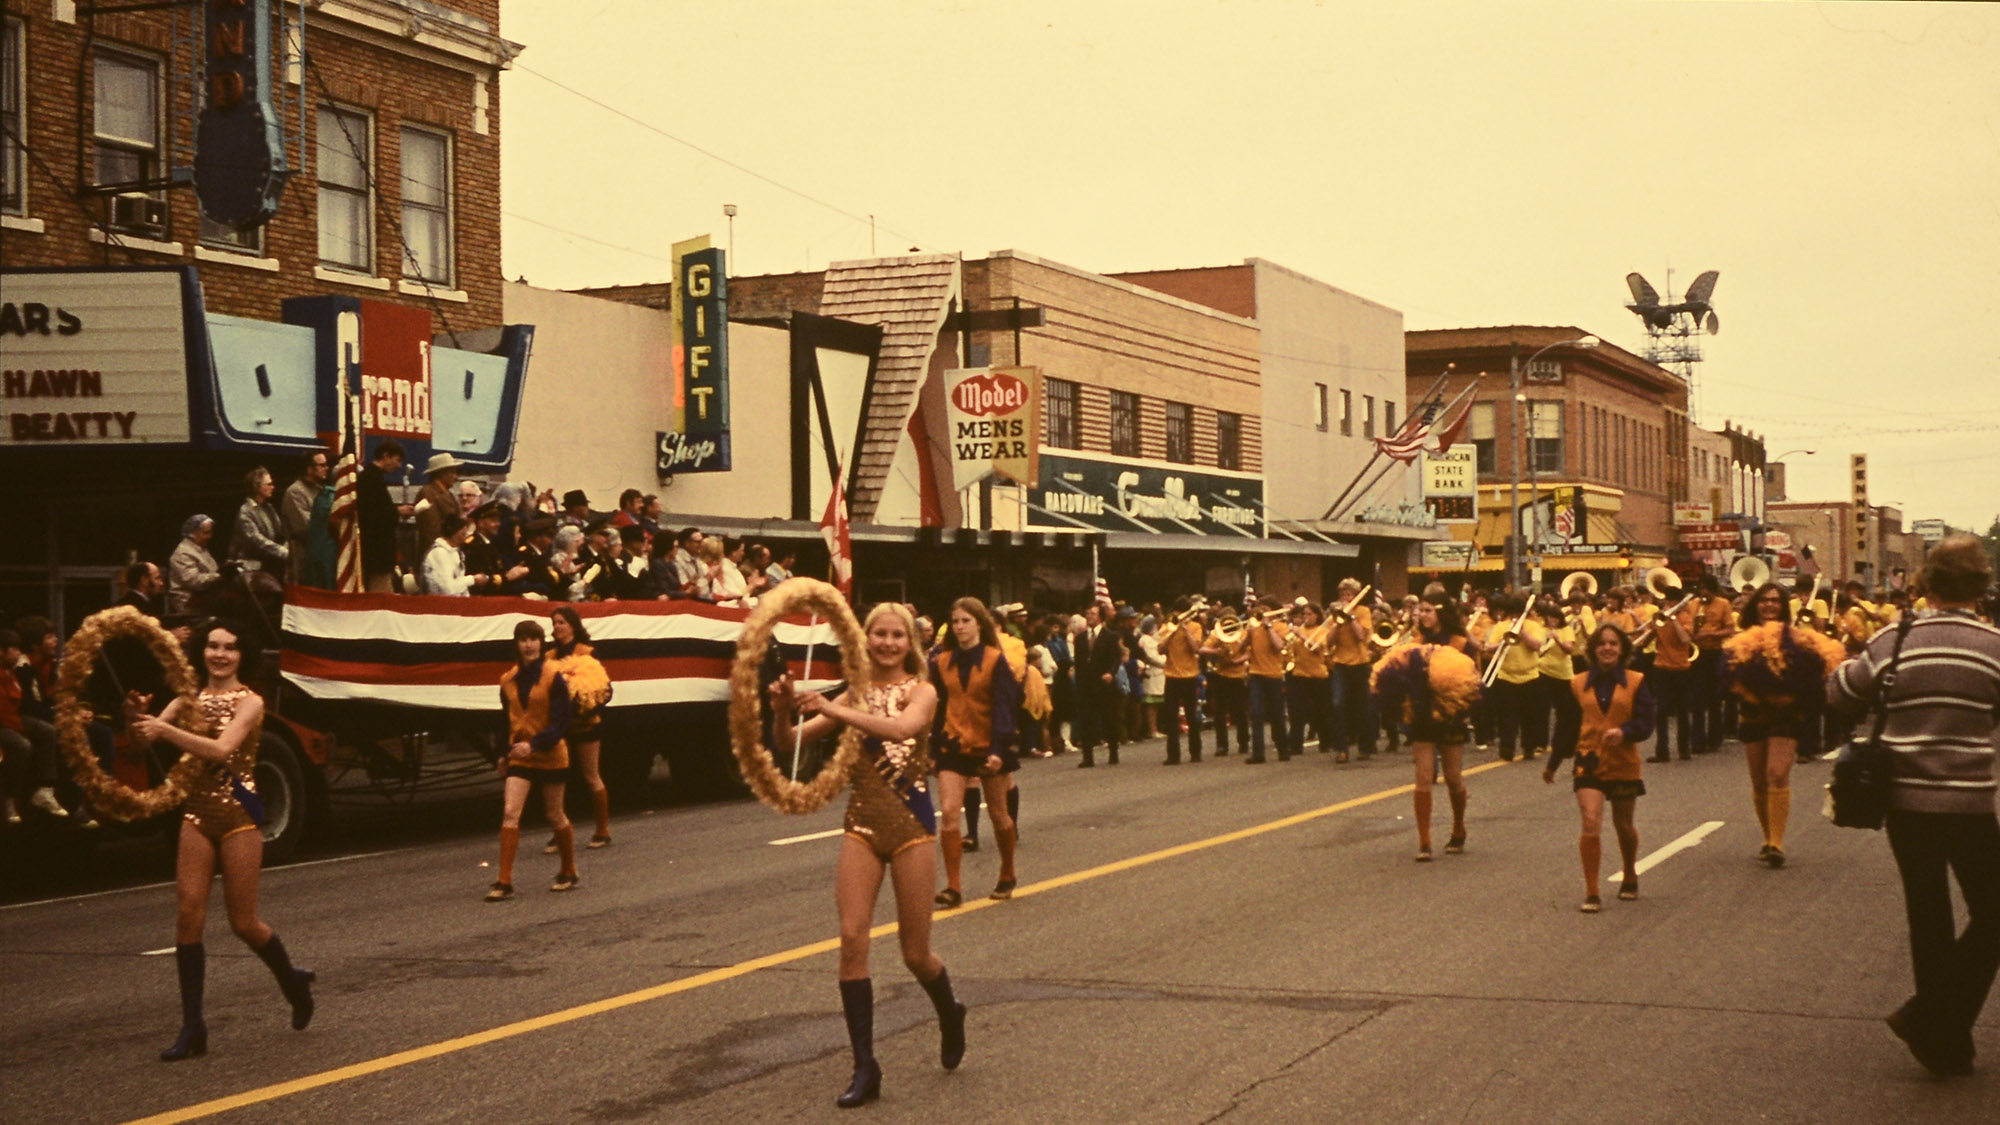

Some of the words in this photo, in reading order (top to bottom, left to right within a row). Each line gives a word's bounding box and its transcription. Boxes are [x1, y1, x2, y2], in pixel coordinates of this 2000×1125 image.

[212, 0, 246, 108] ND
[0, 303, 82, 336] ARS
[688, 264, 714, 420] GIFT
[3, 369, 102, 397] HAWN
[337, 311, 431, 462] Grand
[960, 379, 1022, 413] Model
[11, 411, 137, 440] BEATTY
[957, 419, 1024, 439] MENS
[660, 432, 717, 469] Shop
[956, 441, 1028, 461] WEAR
[1435, 466, 1463, 475] STATE
[1435, 479, 1464, 489] BANK
[1045, 490, 1104, 516] HARDWARE
